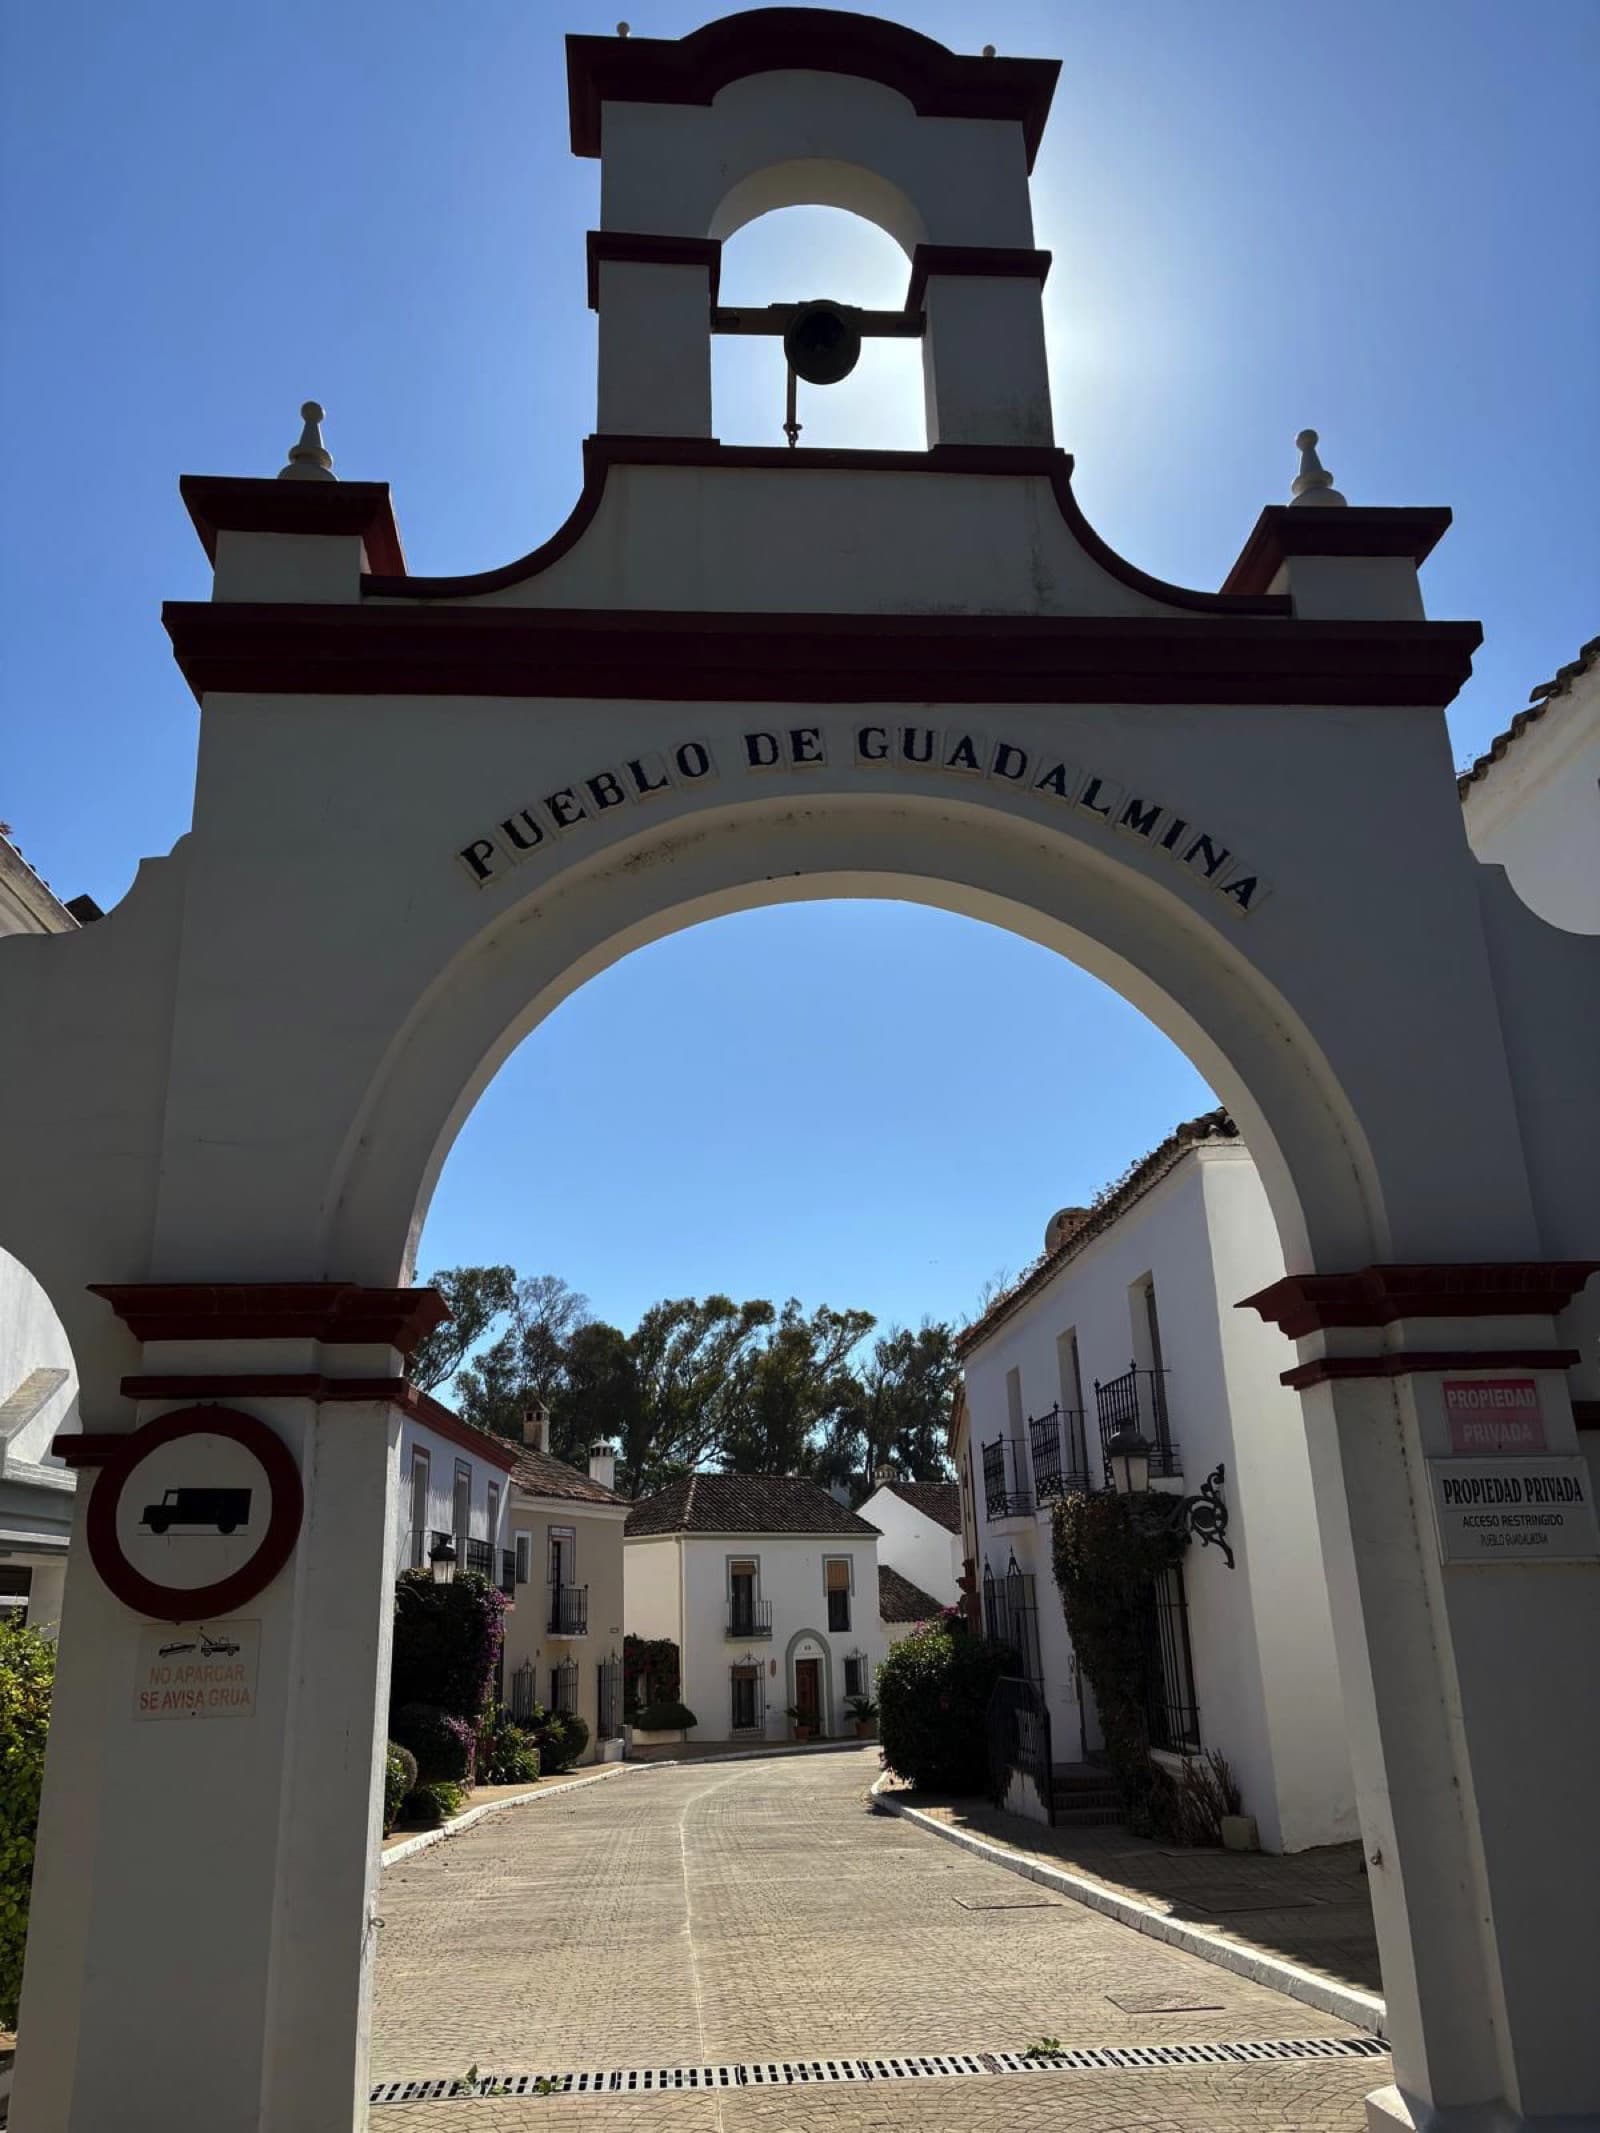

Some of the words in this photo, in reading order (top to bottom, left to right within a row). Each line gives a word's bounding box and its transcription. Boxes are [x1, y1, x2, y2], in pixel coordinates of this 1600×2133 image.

[460, 742, 710, 880] PUEBLO
[744, 728, 823, 767] DE
[857, 727, 1258, 909] GUADALMINA
[1447, 1387, 1536, 1409] PROPIEDAD
[1463, 1423, 1533, 1442] PRIVADA
[1442, 1478, 1522, 1504] PROPIEDAD
[1523, 1477, 1584, 1502] PRIVADA
[1463, 1515, 1499, 1528] ACCESO
[1501, 1514, 1564, 1527] RESTRINGIDO
[150, 1666, 172, 1685] NO
[140, 1691, 159, 1710] SE
[161, 1690, 204, 1709] AVISA
